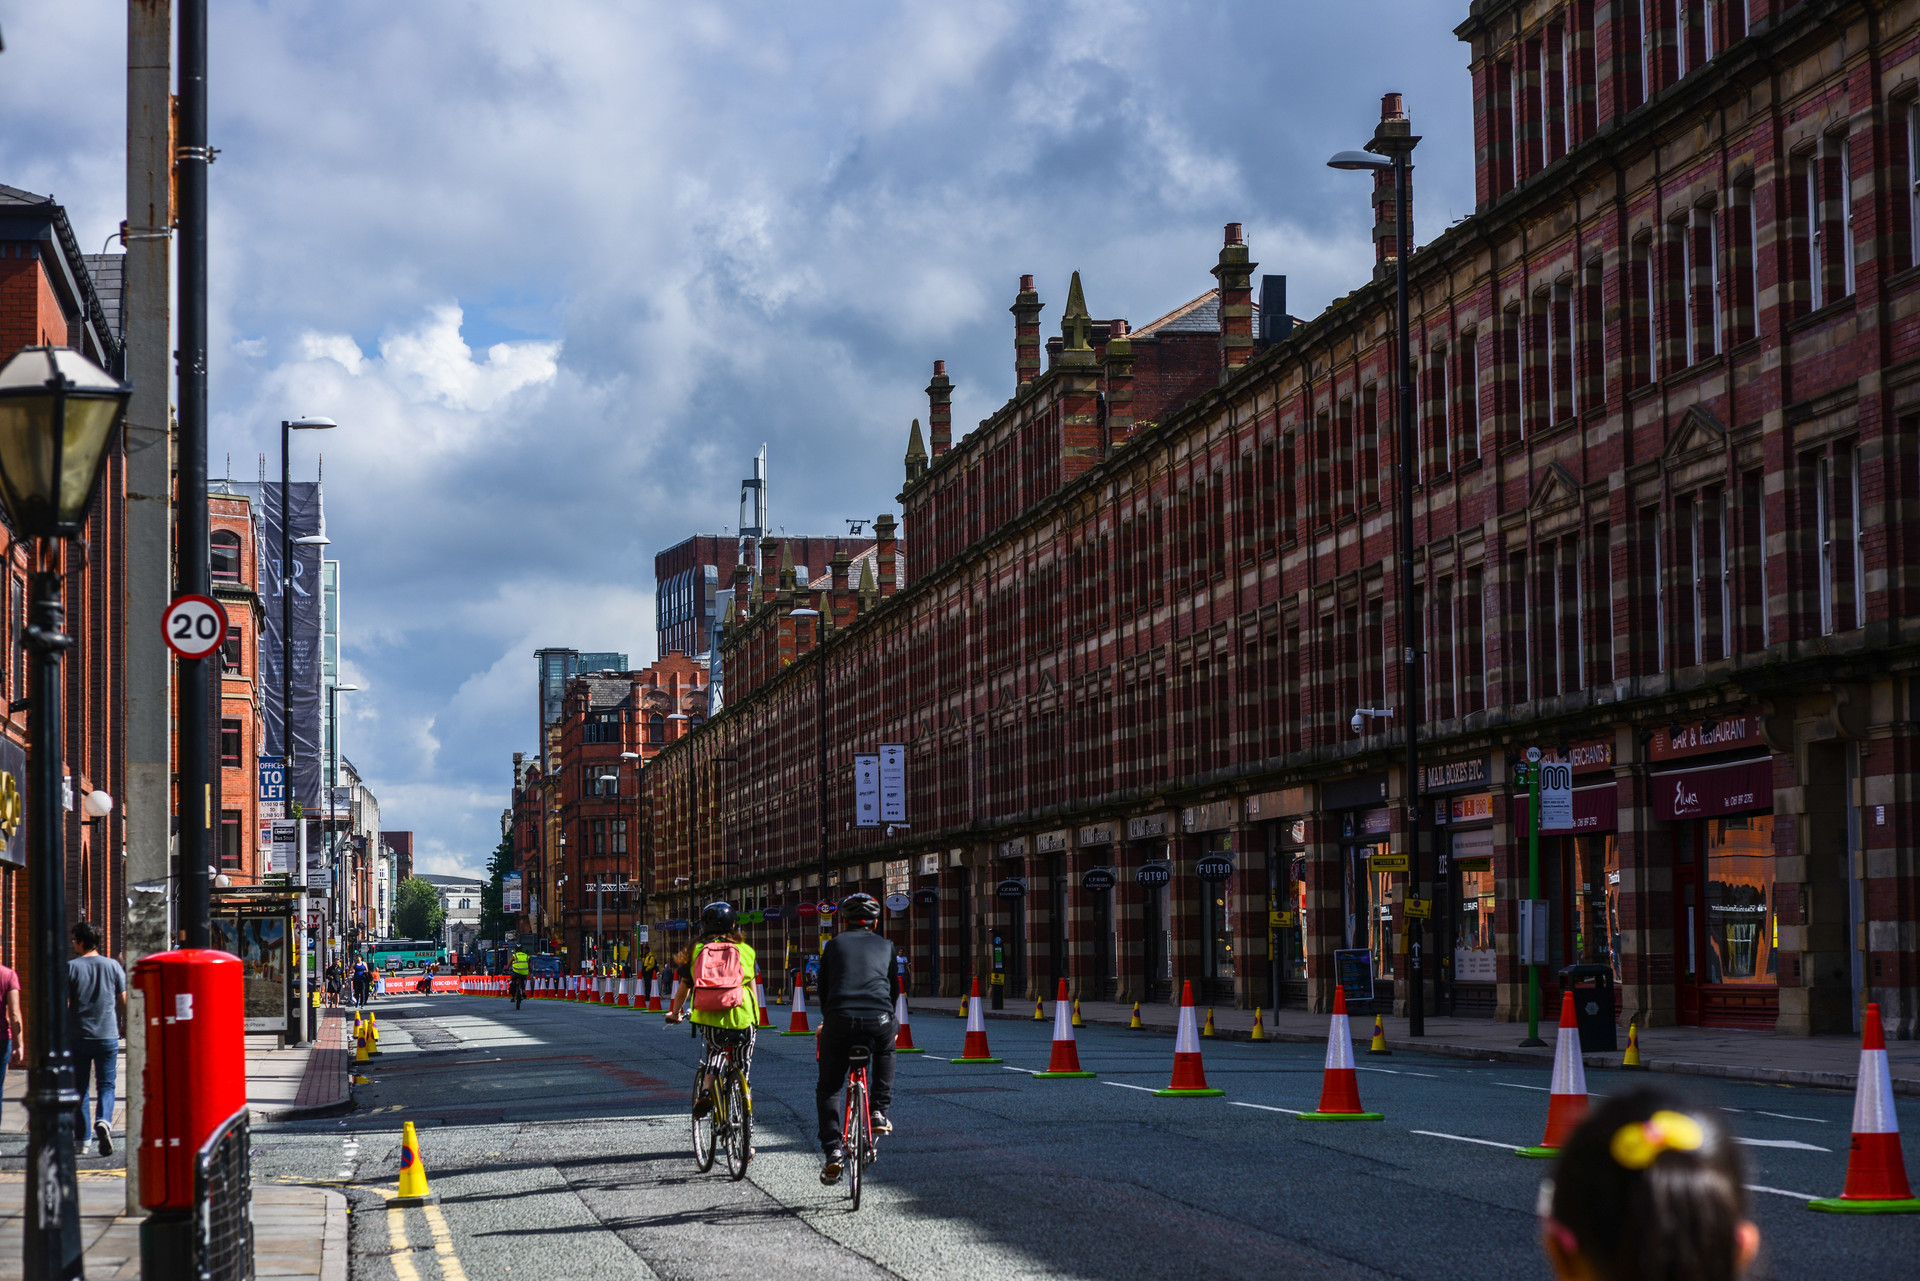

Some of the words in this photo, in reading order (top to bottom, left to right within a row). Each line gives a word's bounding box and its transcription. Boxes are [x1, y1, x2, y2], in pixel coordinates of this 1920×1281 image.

[173, 614, 217, 639] 20
[1672, 730, 1687, 750] BAR
[1690, 728, 1697, 747] &
[1569, 744, 1604, 767] MERCHANTS
[262, 771, 282, 784] TO
[1428, 766, 1445, 788] MAIL
[1446, 762, 1468, 785] BOXES
[1468, 758, 1484, 781] ETC.
[1518, 776, 1525, 784] 2
[261, 785, 285, 798] LET
[1199, 864, 1230, 874] FUTON
[1138, 871, 1168, 881] FUTON
